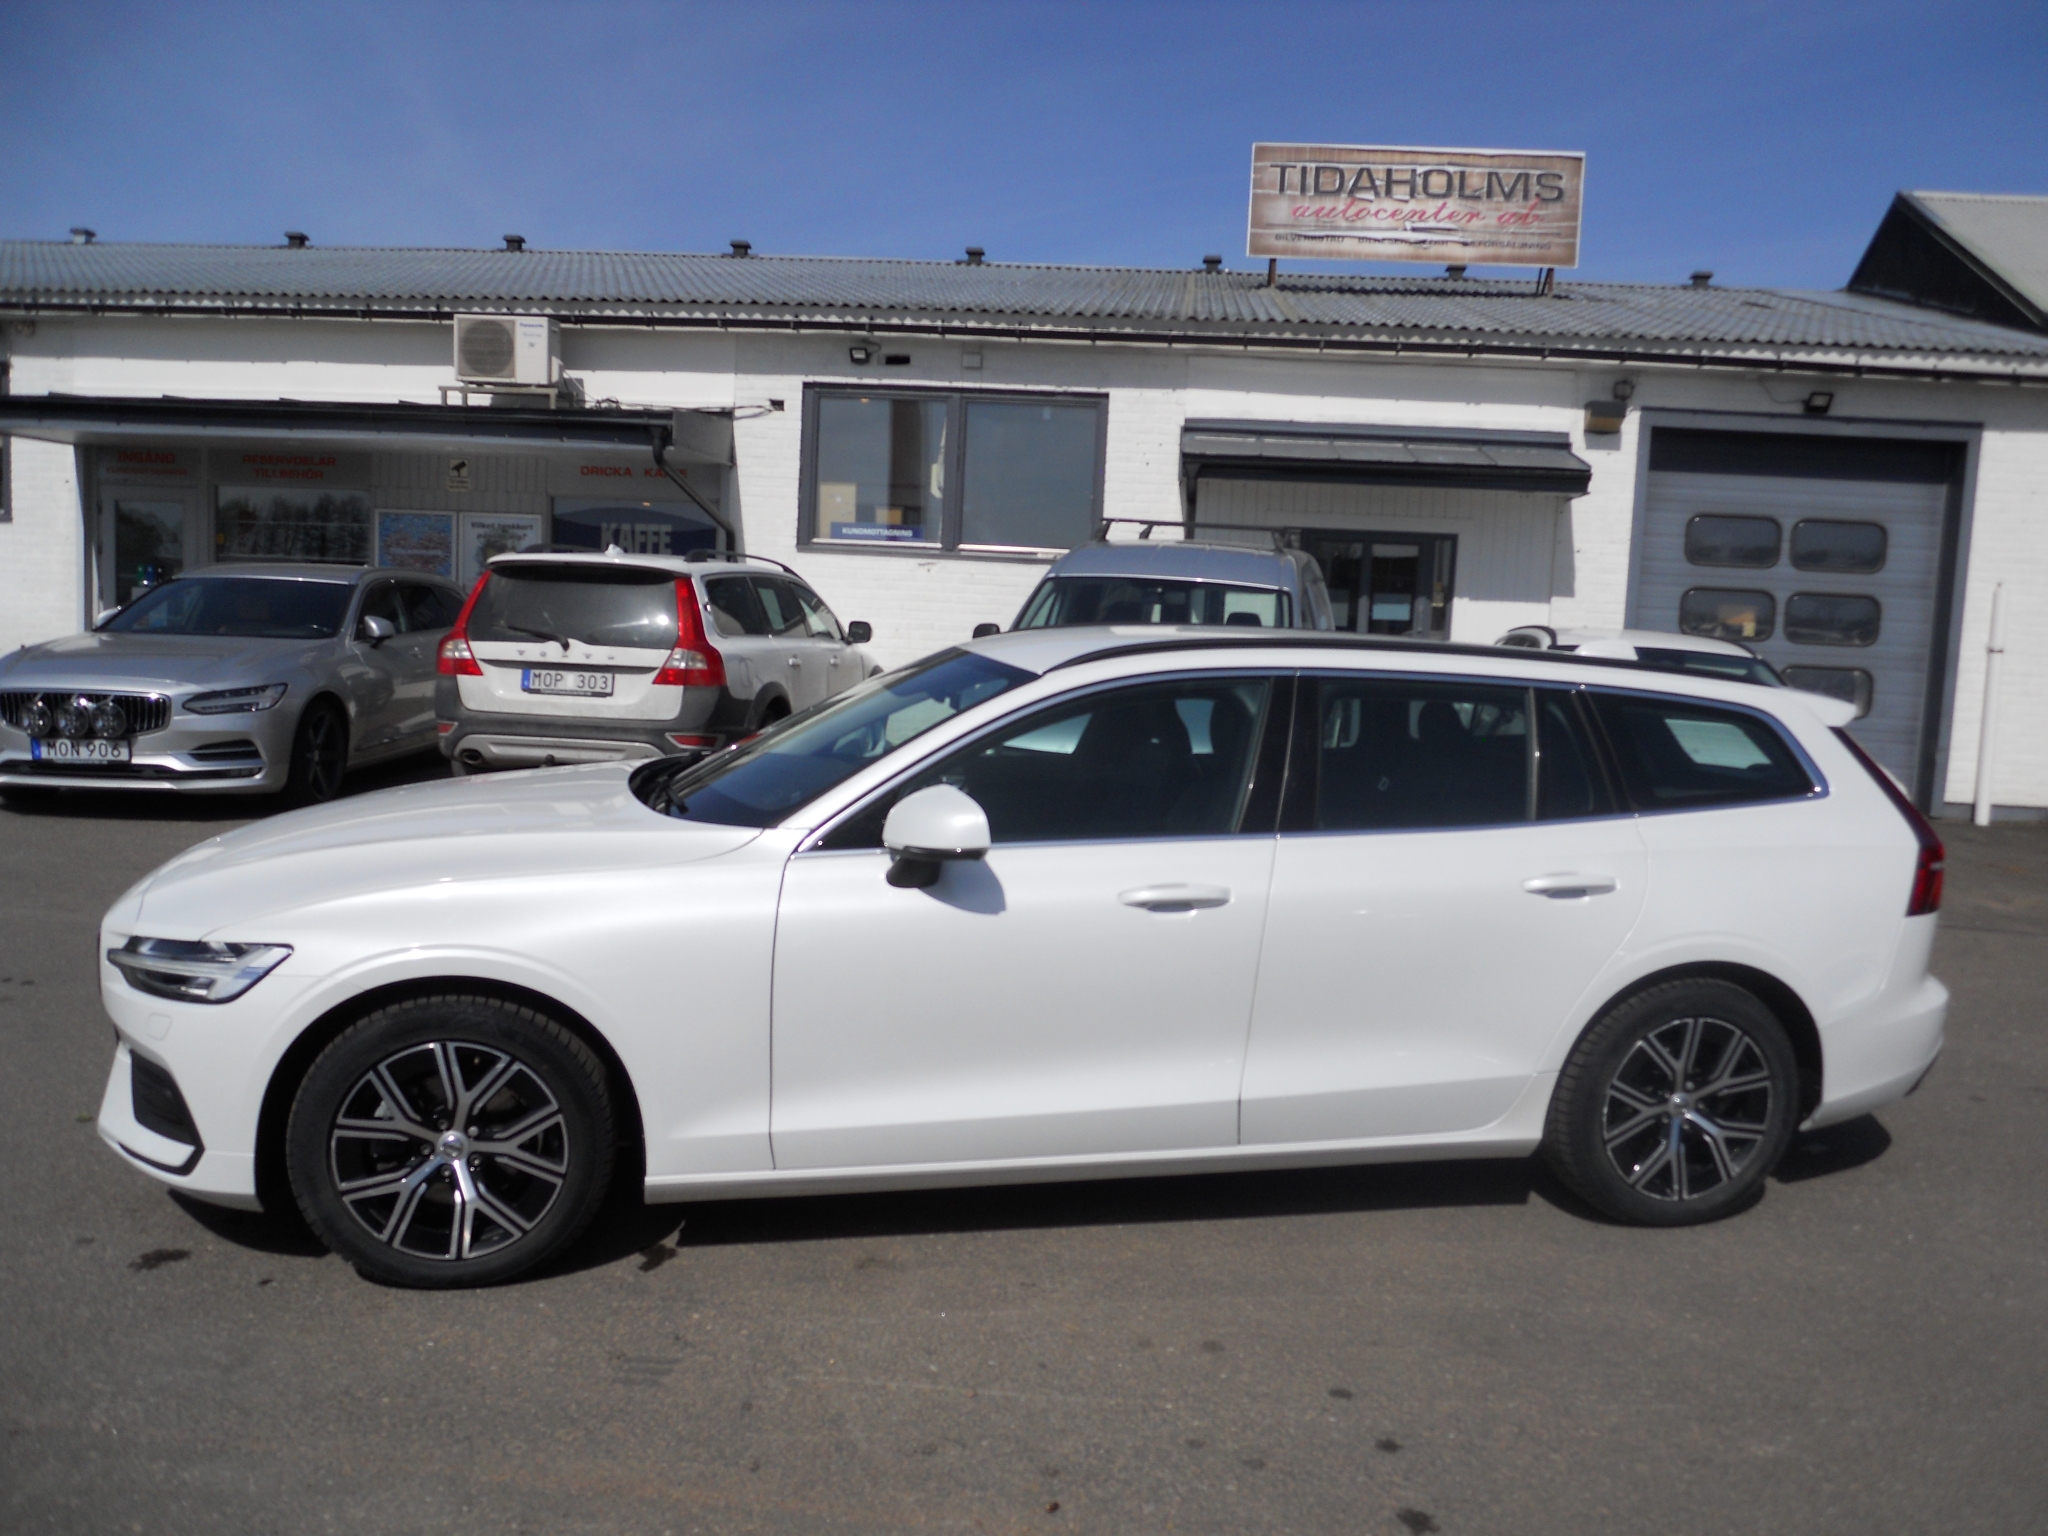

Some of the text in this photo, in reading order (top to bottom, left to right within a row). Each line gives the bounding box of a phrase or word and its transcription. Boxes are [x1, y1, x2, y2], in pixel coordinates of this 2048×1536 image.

[1269, 163, 1565, 202] TIDAHOLMS
[1291, 195, 1545, 226] autocenter ab
[580, 465, 688, 478] DRICKA KAE
[601, 522, 673, 554] KAFFE
[531, 672, 609, 690] MOP 303
[46, 741, 121, 758] MON 906
